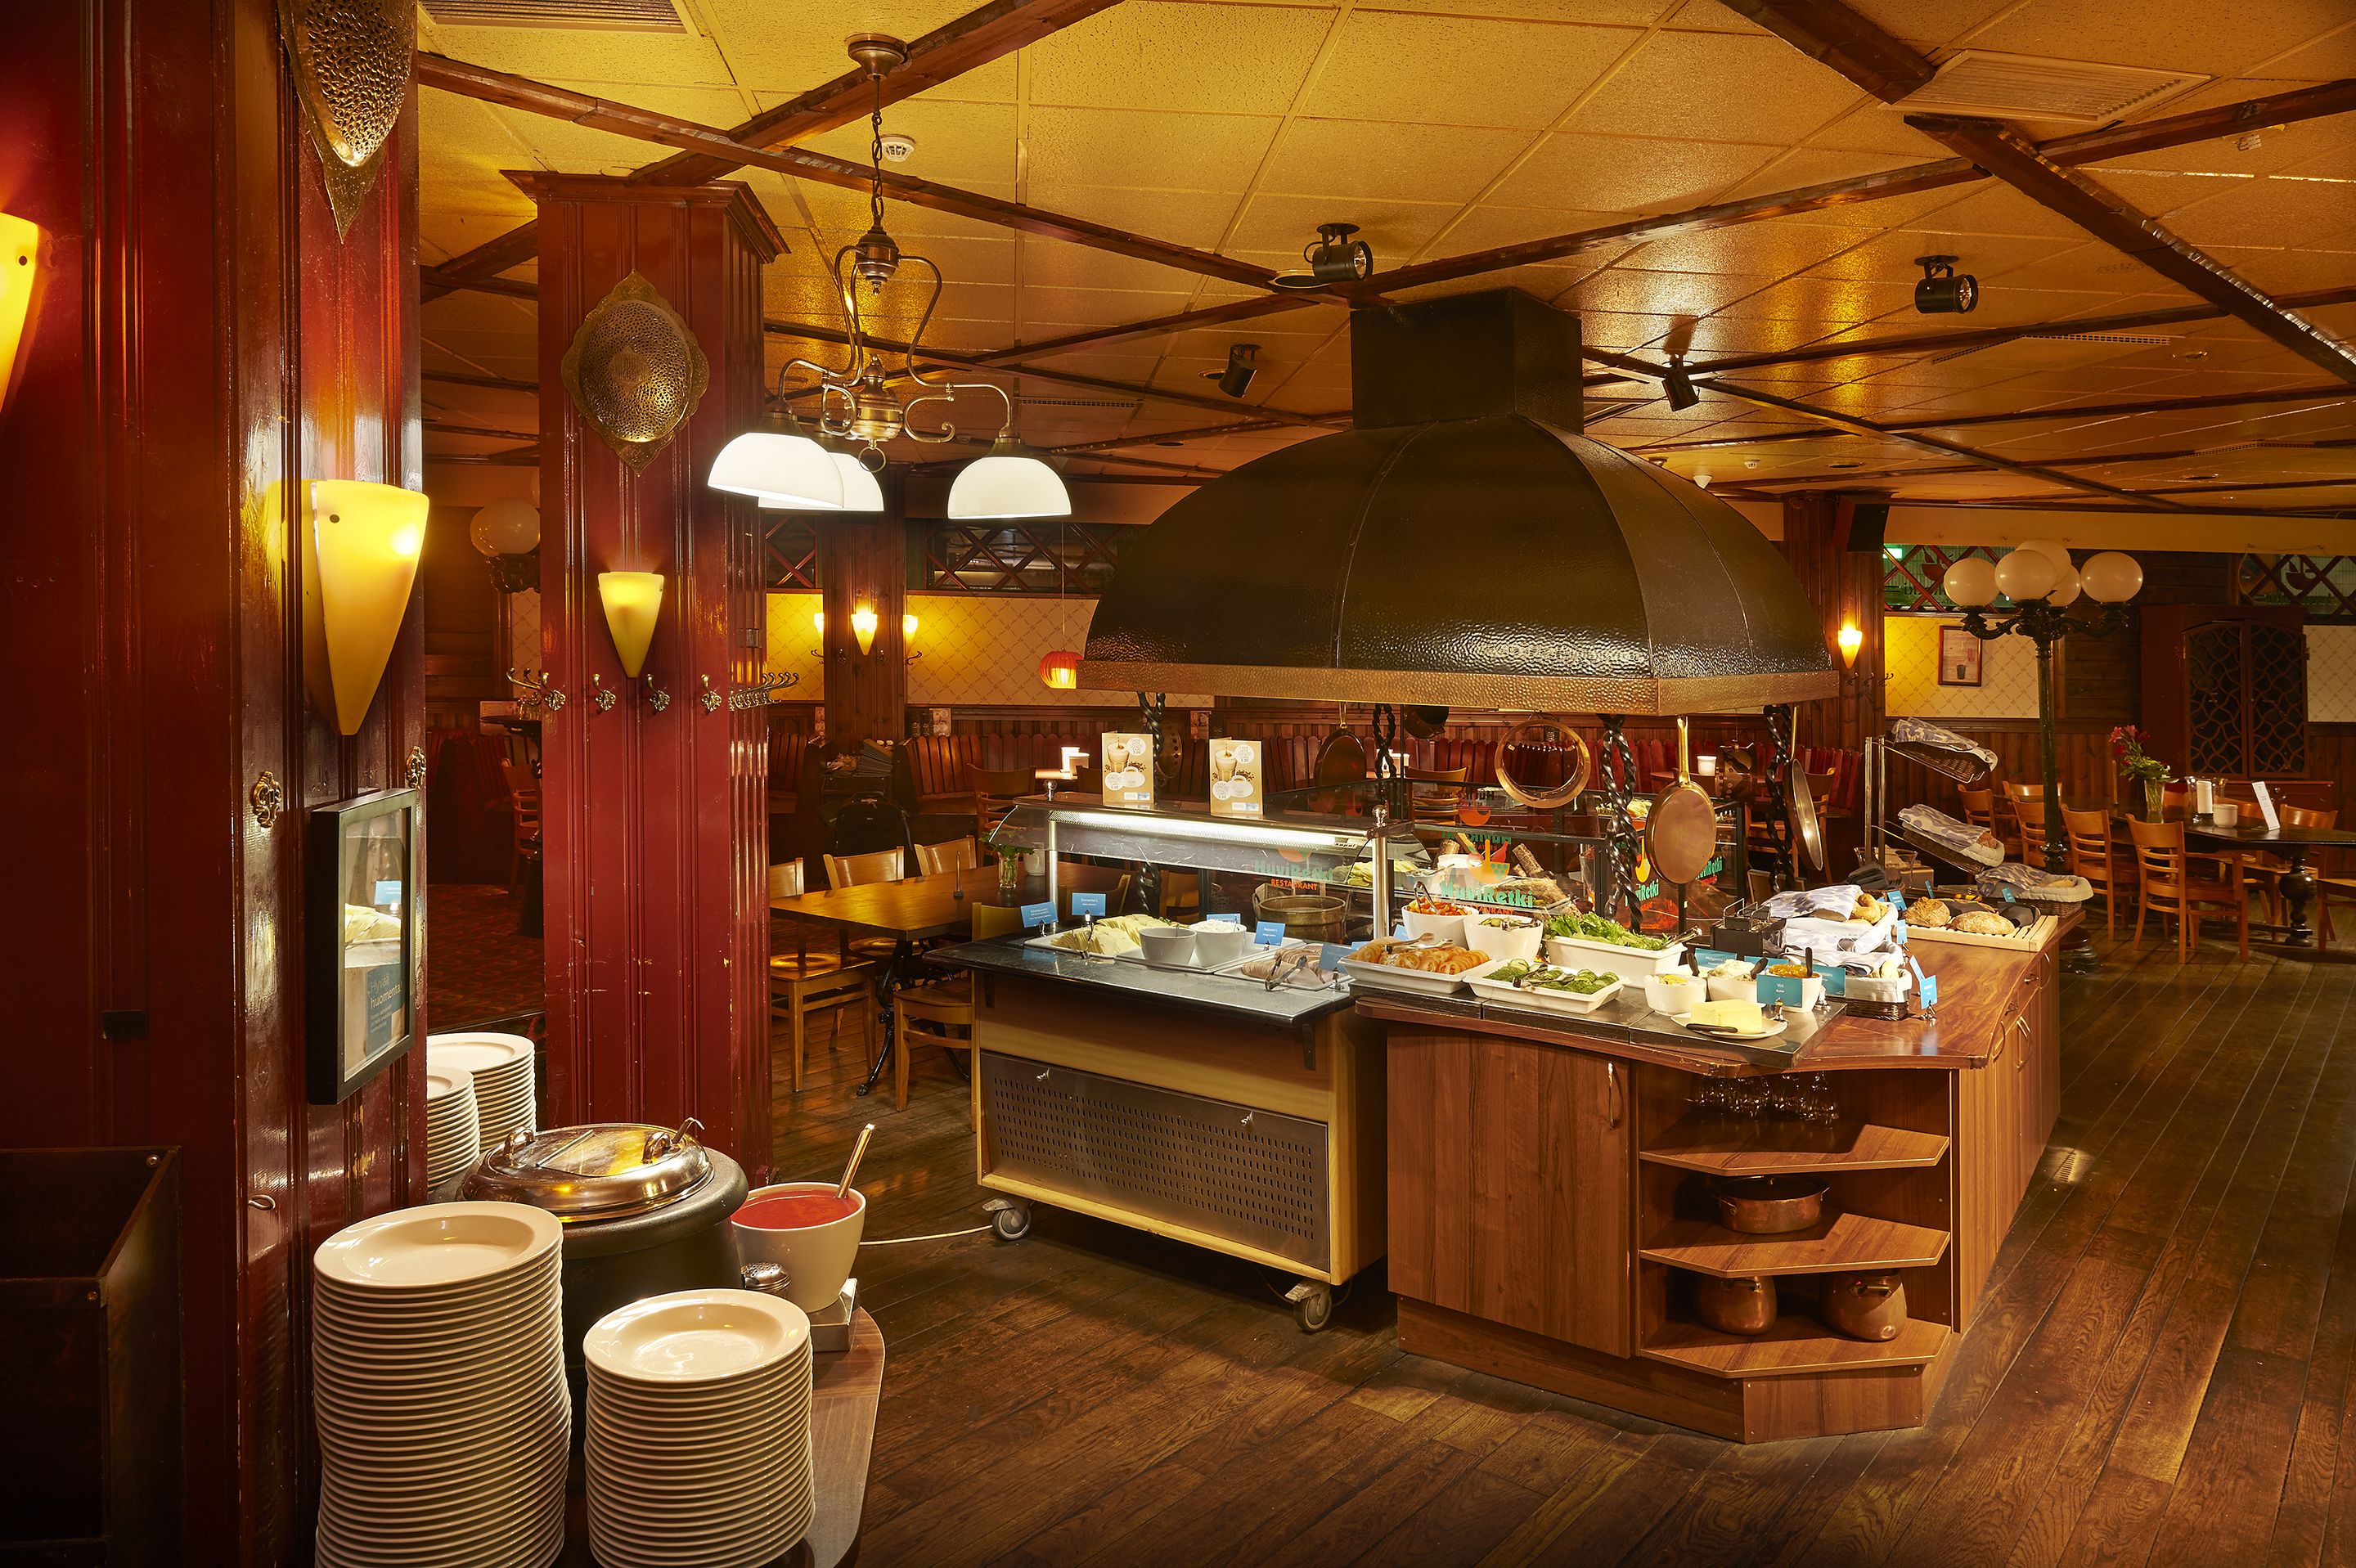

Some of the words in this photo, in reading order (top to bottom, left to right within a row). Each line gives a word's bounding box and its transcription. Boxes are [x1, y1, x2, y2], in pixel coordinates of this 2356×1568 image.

[1270, 878, 1318, 891] RESTAURANT
[1440, 881, 1533, 909] HuviRetki
[370, 981, 402, 1009] huomenta!
